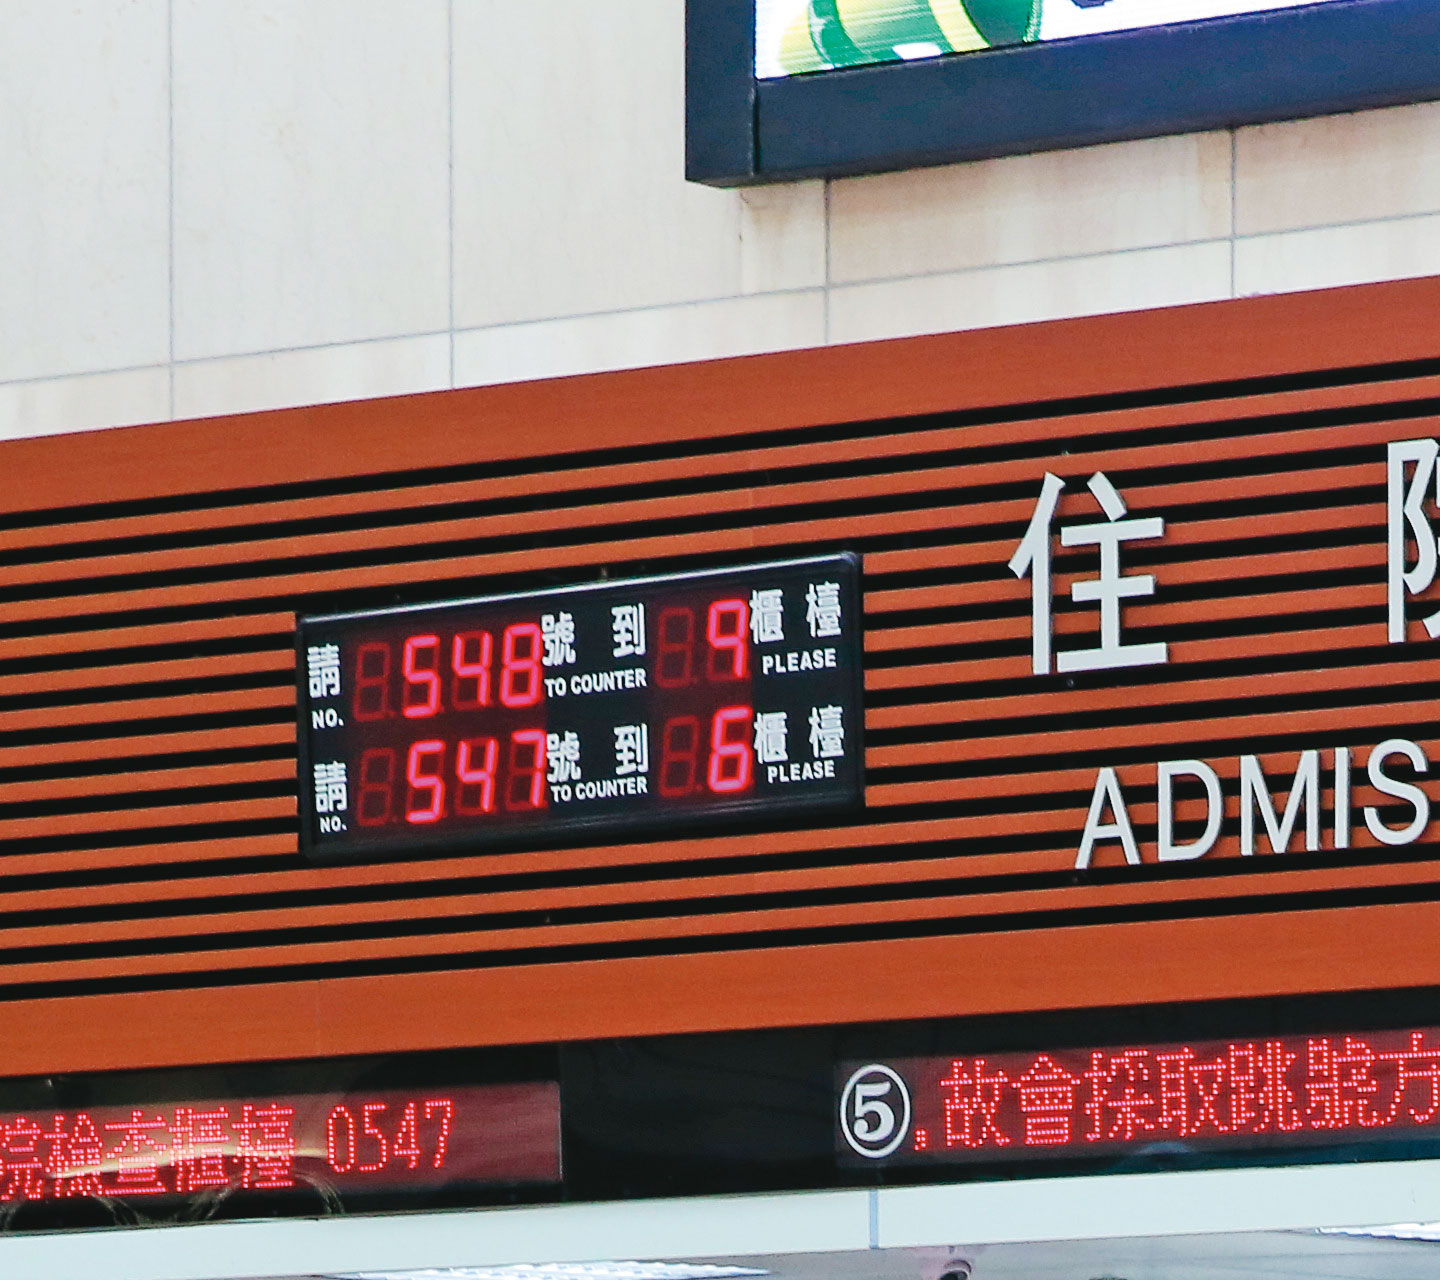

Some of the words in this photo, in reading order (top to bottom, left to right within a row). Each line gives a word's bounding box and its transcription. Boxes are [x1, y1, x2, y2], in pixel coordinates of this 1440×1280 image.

[312, 709, 344, 730] NO.
[544, 678, 567, 699] TO
[571, 669, 648, 694] COUNTER
[762, 648, 838, 675] PLEASE
[319, 816, 348, 833] NO.
[550, 784, 573, 803] TO
[575, 776, 649, 800] COUNTER
[767, 760, 836, 785] PLEASE
[326, 1098, 456, 1173] 0547
